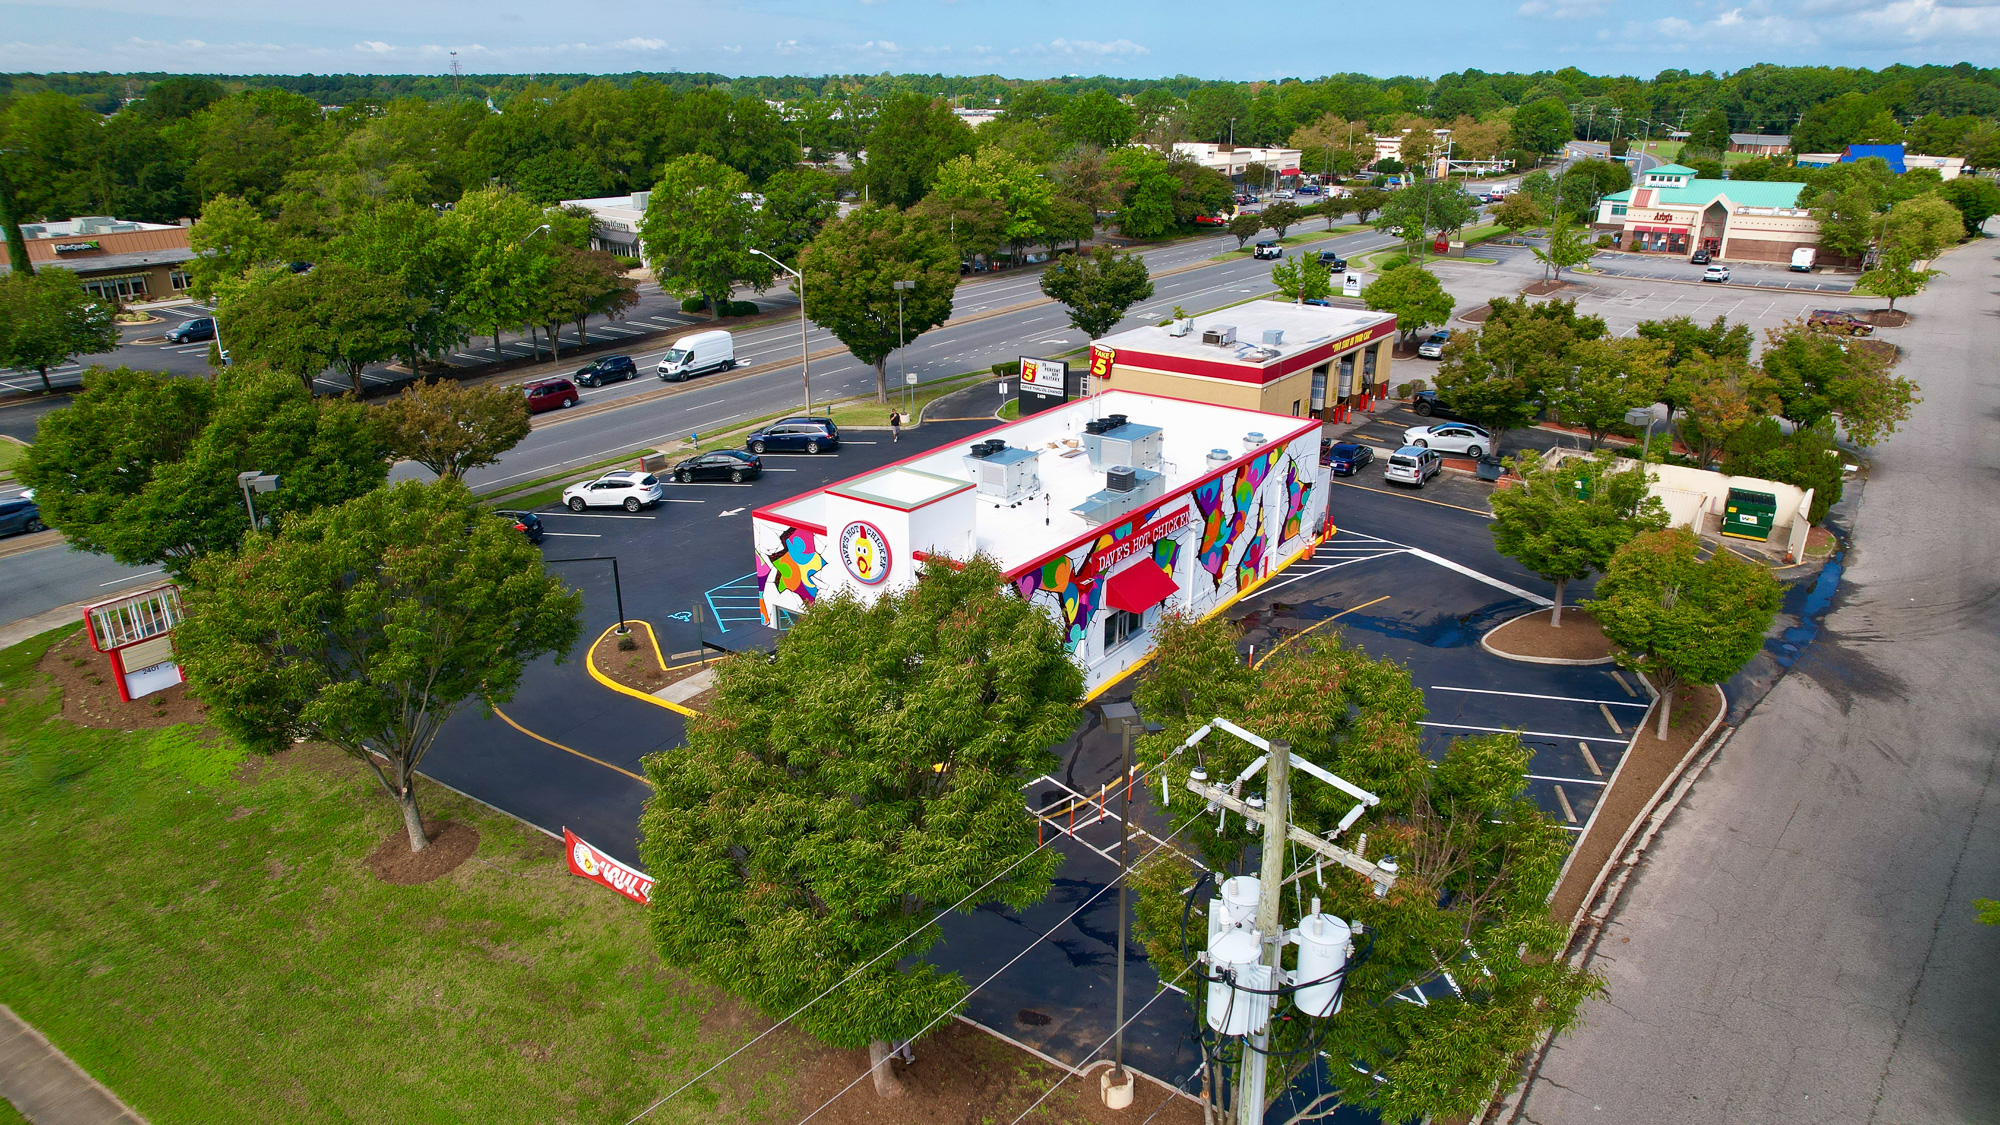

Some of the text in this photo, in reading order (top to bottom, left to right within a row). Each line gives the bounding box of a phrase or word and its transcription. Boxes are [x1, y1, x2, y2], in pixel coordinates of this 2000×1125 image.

[1095, 348, 1110, 360] TAKE
[1024, 361, 1036, 369] TAKE
[1093, 358, 1107, 375] 5
[1023, 368, 1033, 381] 5
[843, 525, 887, 569] DAVE'S HOT CHICKEN
[1098, 510, 1191, 572] DAVE'S HOT CHICKEN
[143, 664, 160, 675] 2401
